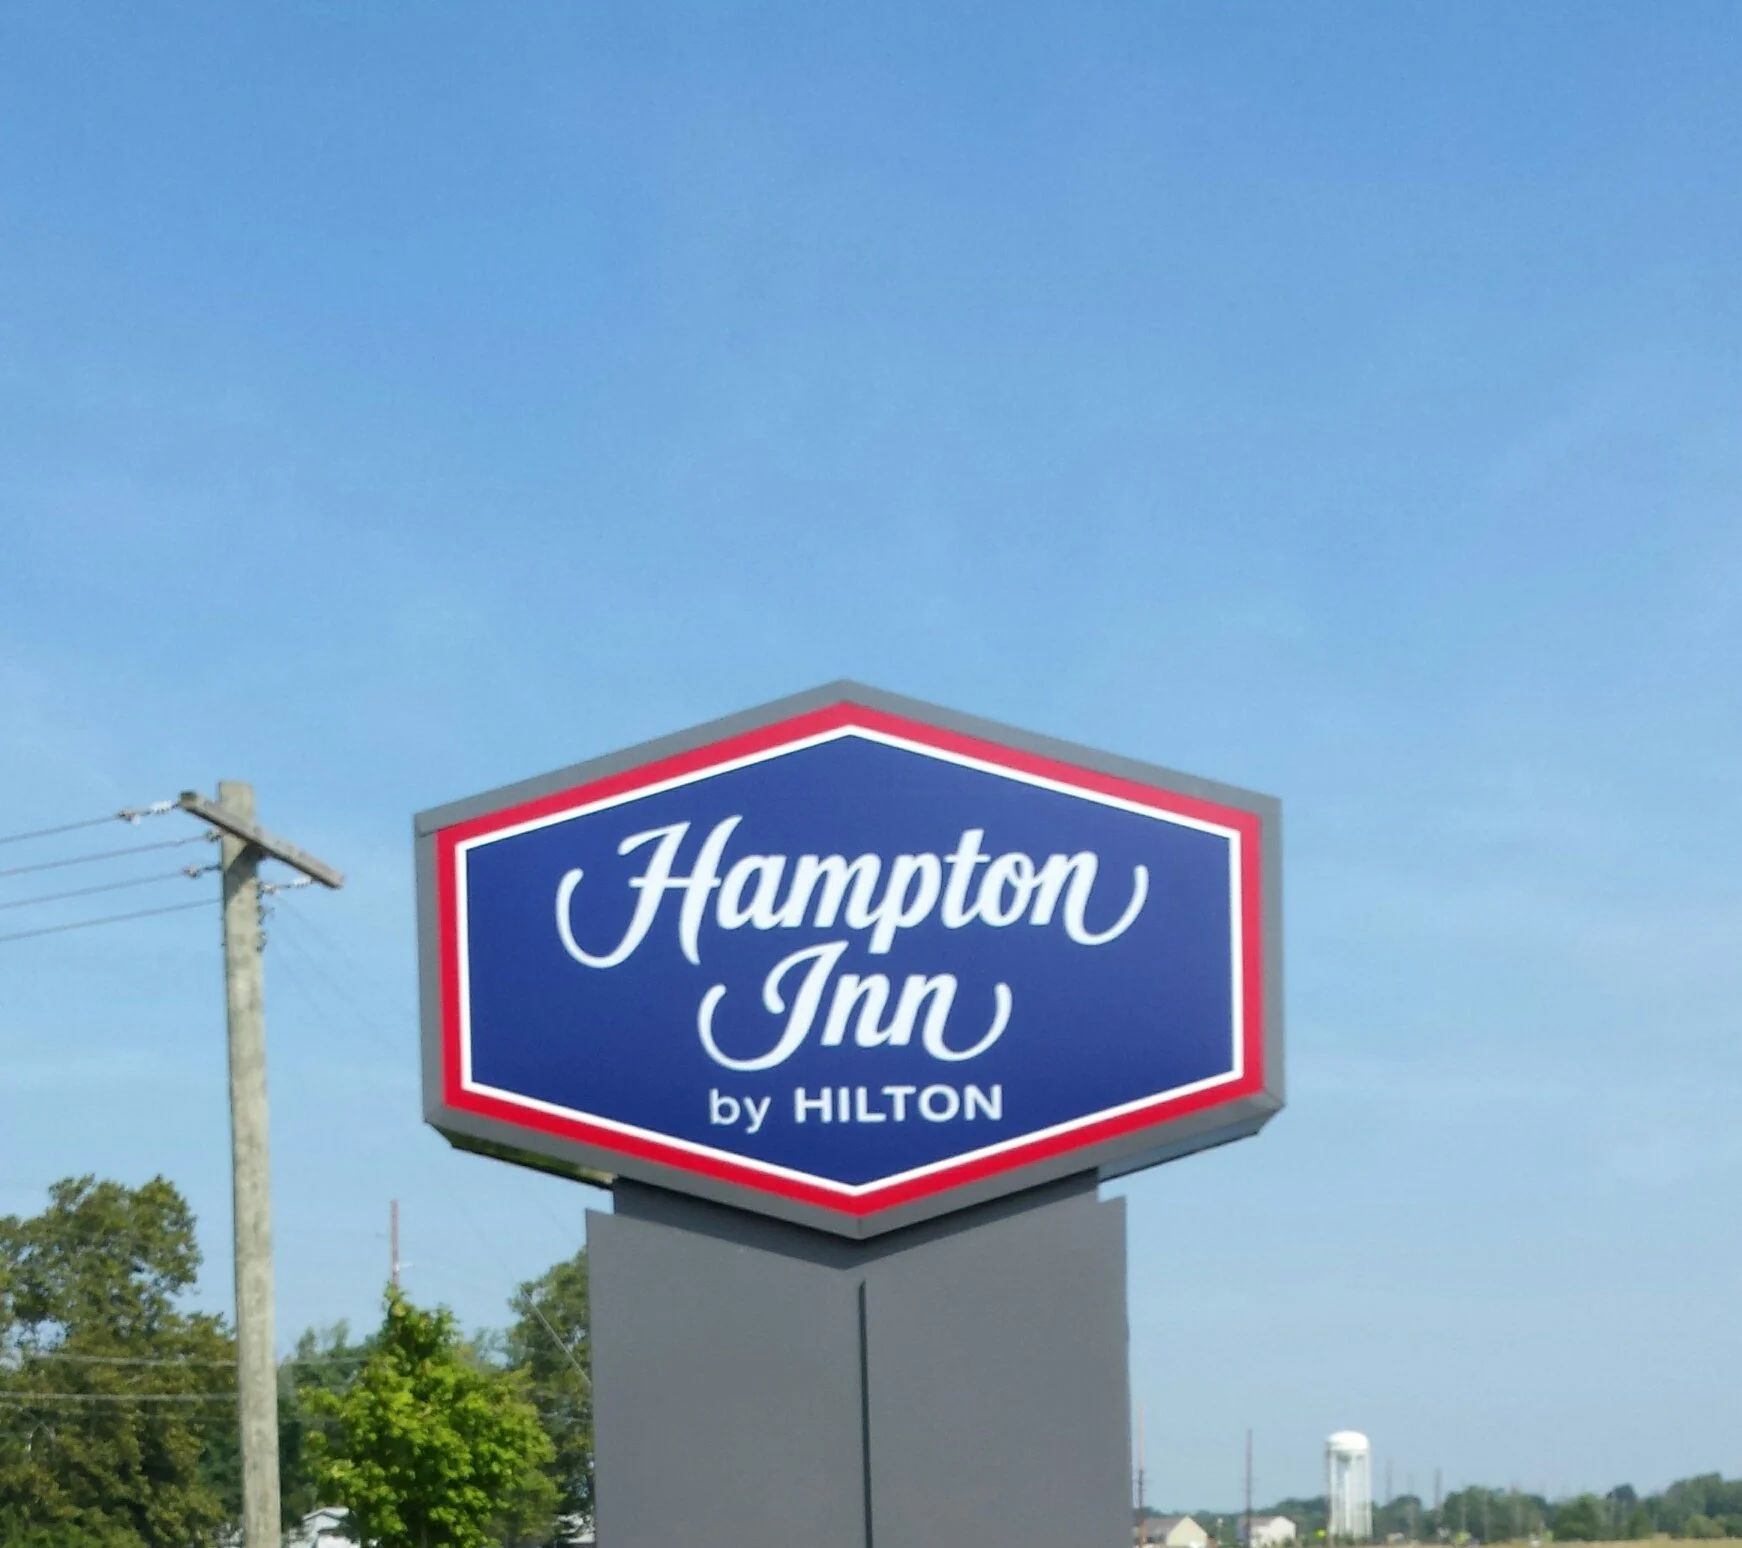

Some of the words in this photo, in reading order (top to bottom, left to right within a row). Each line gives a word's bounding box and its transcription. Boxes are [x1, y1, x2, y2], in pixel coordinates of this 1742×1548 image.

[555, 815, 1149, 969] Hampton
[697, 940, 1013, 1071] Inn
[709, 1088, 771, 1134] by
[794, 1084, 1003, 1123] HILTON
